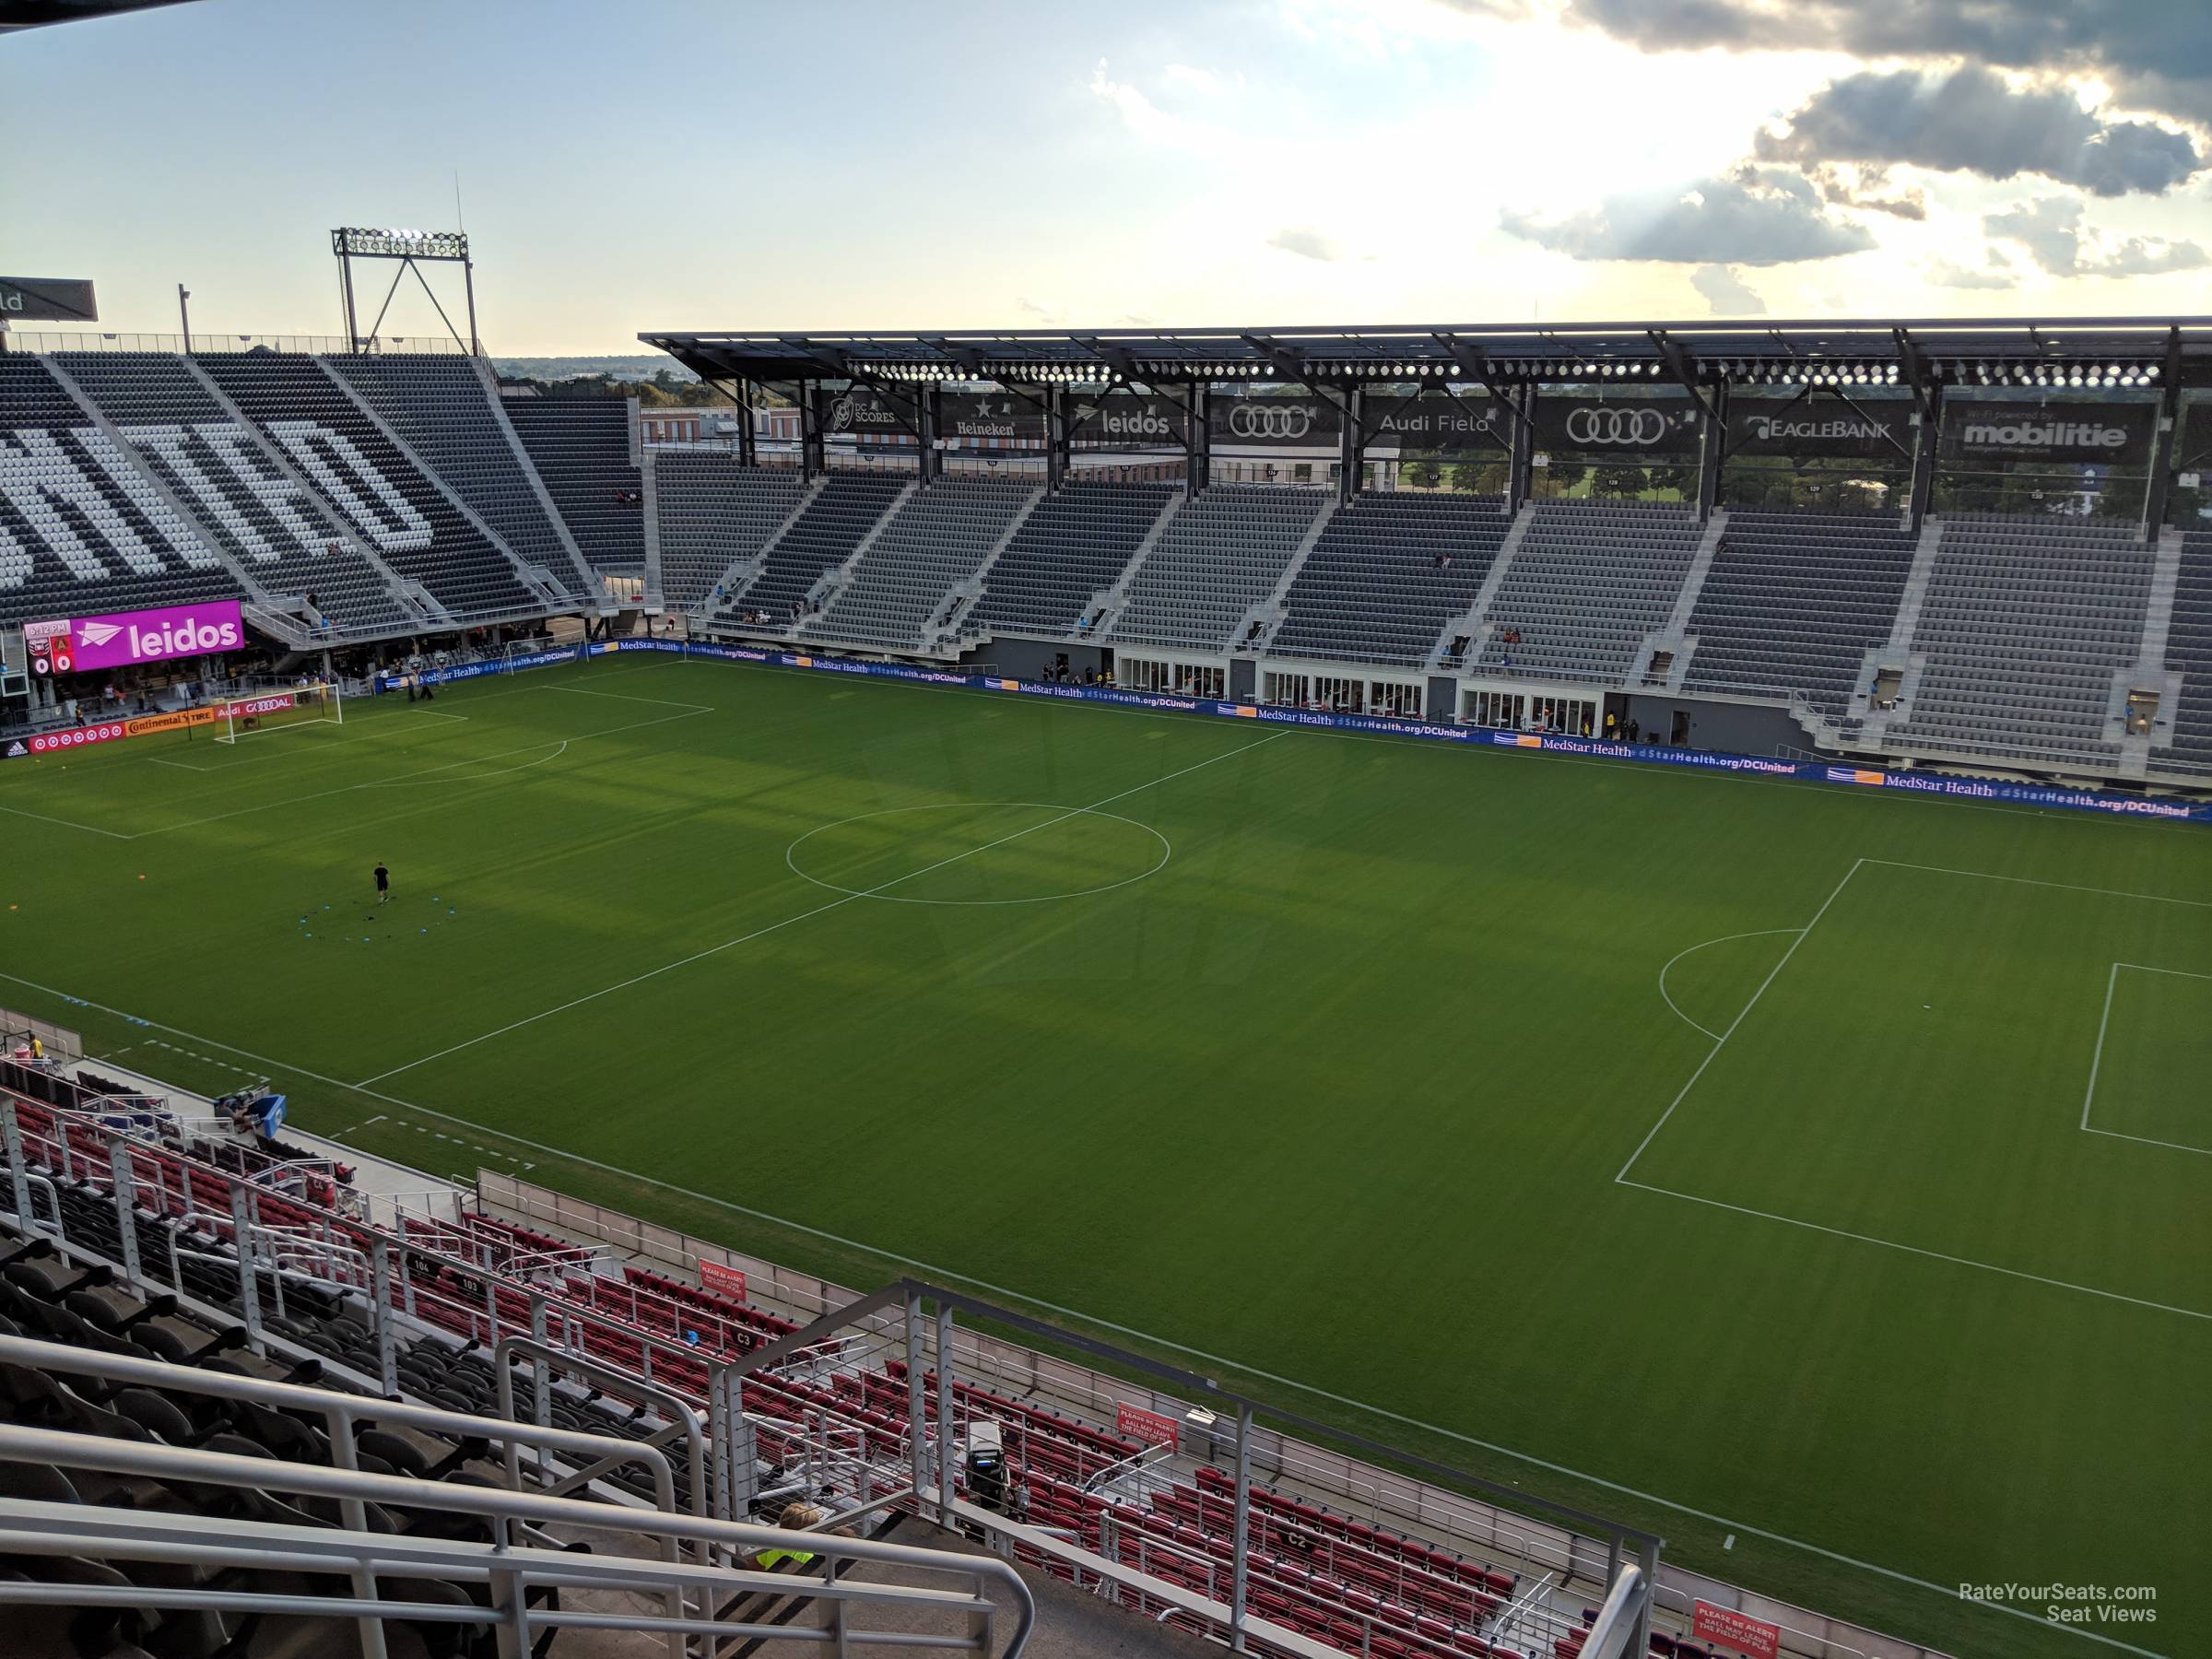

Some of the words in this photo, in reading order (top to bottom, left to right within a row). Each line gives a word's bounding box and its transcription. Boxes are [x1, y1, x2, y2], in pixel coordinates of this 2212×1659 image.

[854, 403, 867, 412] DC
[855, 412, 895, 423] SCORES
[1102, 409, 1170, 434] leidos
[1380, 416, 1430, 431] Audi
[1438, 416, 1489, 431] Field
[957, 421, 1014, 436] Heineken
[1963, 421, 2127, 447] mobilitie
[51, 623, 65, 633] PM
[129, 618, 238, 658] leidos
[619, 640, 655, 650] MedStar
[656, 641, 679, 652] Health
[35, 658, 49, 674] 0
[58, 655, 71, 671] 0
[813, 659, 842, 671] MedStar
[843, 663, 869, 674] Health
[453, 665, 480, 680] Health
[1019, 683, 1053, 695] MedStar
[1054, 686, 1082, 698] Health
[218, 706, 241, 717] Audi
[1258, 709, 1298, 722] MedStar
[1299, 713, 1332, 726] Health
[129, 715, 182, 734] Continental
[191, 712, 211, 722] TIRE
[7, 748, 29, 757] adidas
[1543, 738, 1591, 755] MedStar
[1593, 743, 1632, 758] Health
[1887, 774, 1944, 792] MedStar
[1946, 781, 1993, 797] Health
[415, 1259, 429, 1272] 104
[463, 1278, 477, 1291] 103
[737, 1332, 750, 1346] C3
[1121, 1409, 1145, 1421] PLEASE
[1122, 1423, 1133, 1432] THE
[1133, 1428, 1149, 1438] FIELD
[1125, 1419, 1139, 1428] BALL
[1140, 1424, 1153, 1432] MAY
[1153, 1429, 1171, 1439] LEAVE
[1288, 1532, 1306, 1548] C2
[1699, 1607, 1731, 1624] PLEASE
[1733, 1620, 1745, 1629] BE
[1746, 1625, 1775, 1640] ALERT!
[1699, 1622, 1714, 1632] THE
[1715, 1627, 1738, 1640] FIELD
[1739, 1636, 1750, 1644] OF
[1705, 1618, 1724, 1629] BALL
[1724, 1625, 1742, 1635] MAY
[1744, 1631, 1769, 1645] LEAVE
